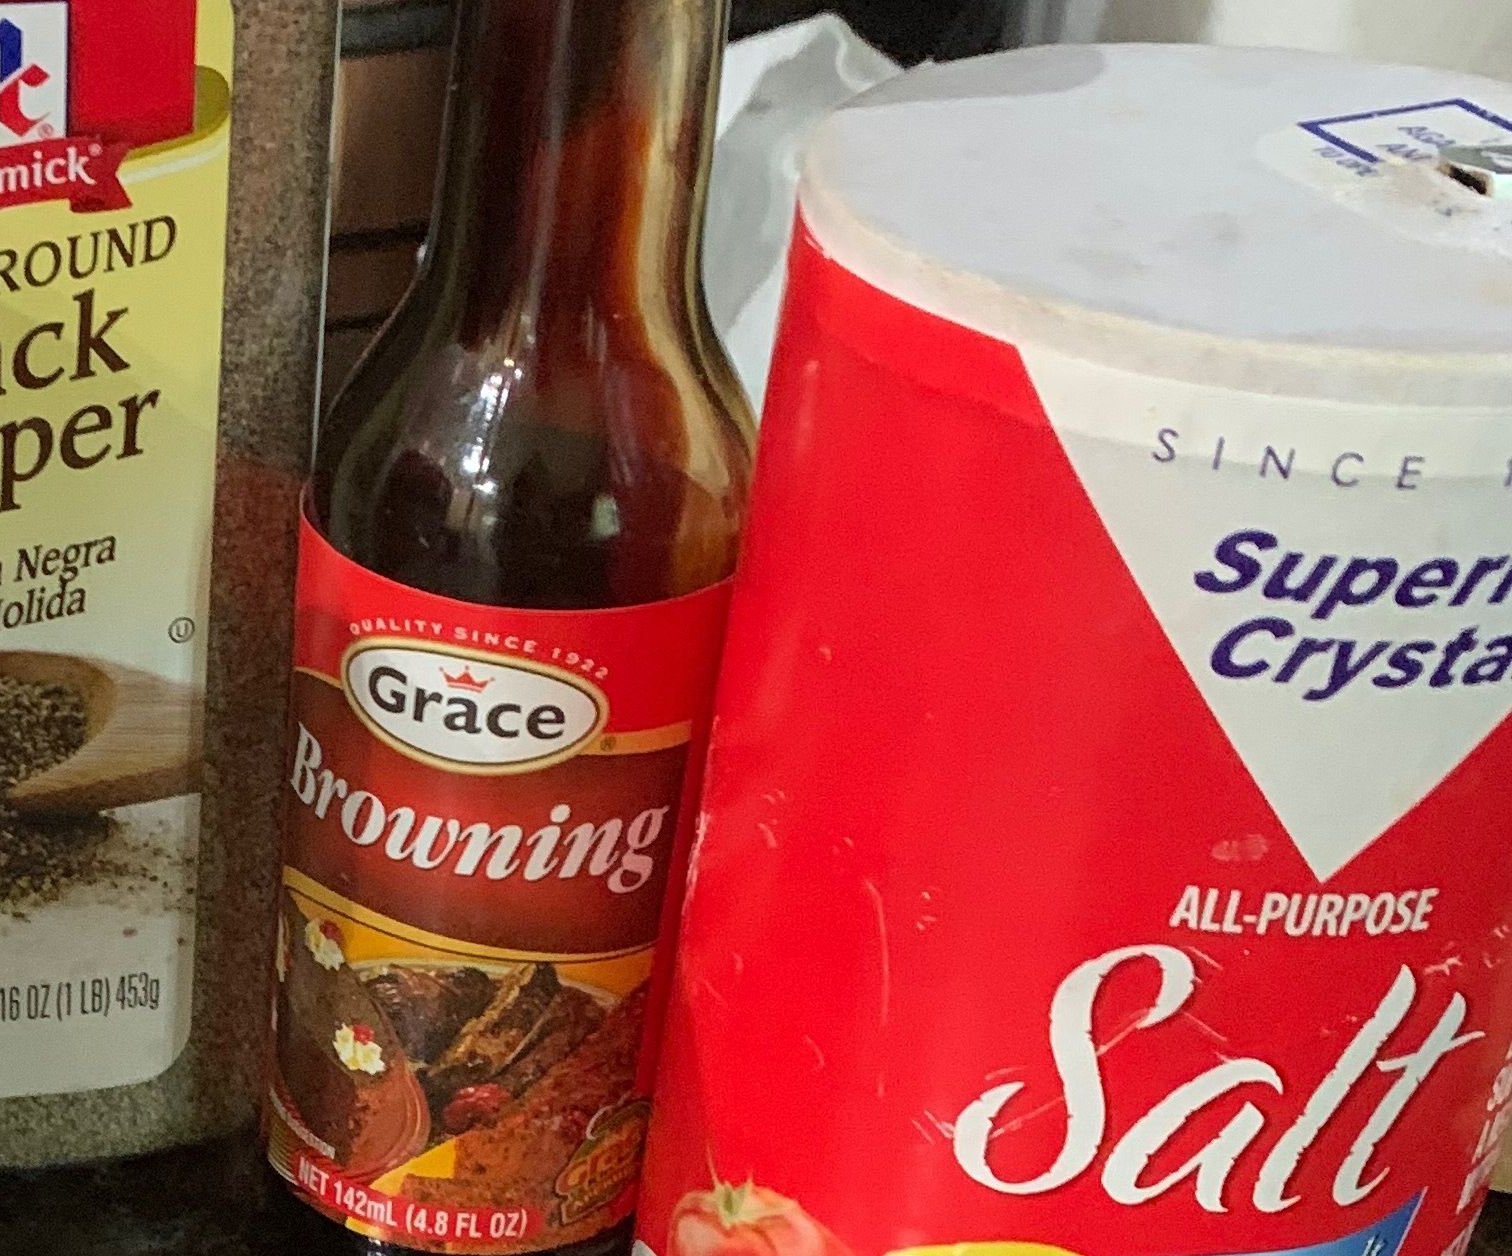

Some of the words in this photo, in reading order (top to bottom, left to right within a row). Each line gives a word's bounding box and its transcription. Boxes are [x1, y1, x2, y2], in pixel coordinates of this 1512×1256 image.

[1152, 428, 1425, 490] SINCE
[13, 535, 117, 586] Negra
[349, 618, 442, 636] QUALITY
[454, 626, 536, 654] SINCE
[551, 648, 609, 680] 1922
[368, 666, 566, 740] Grace
[290, 721, 670, 895] Browning
[1169, 884, 1440, 938] ALL-PURPOSE
[27, 984, 50, 1020] OZ
[56, 981, 73, 1019] (1
[80, 976, 111, 1019] LB)
[115, 971, 161, 1012] 453g
[953, 943, 1486, 1213] Salt
[298, 1155, 330, 1198] NET
[333, 1180, 399, 1229] 142mL
[405, 1203, 449, 1238] (4.8
[456, 1212, 482, 1240] FL
[489, 1208, 528, 1239] OZ)
